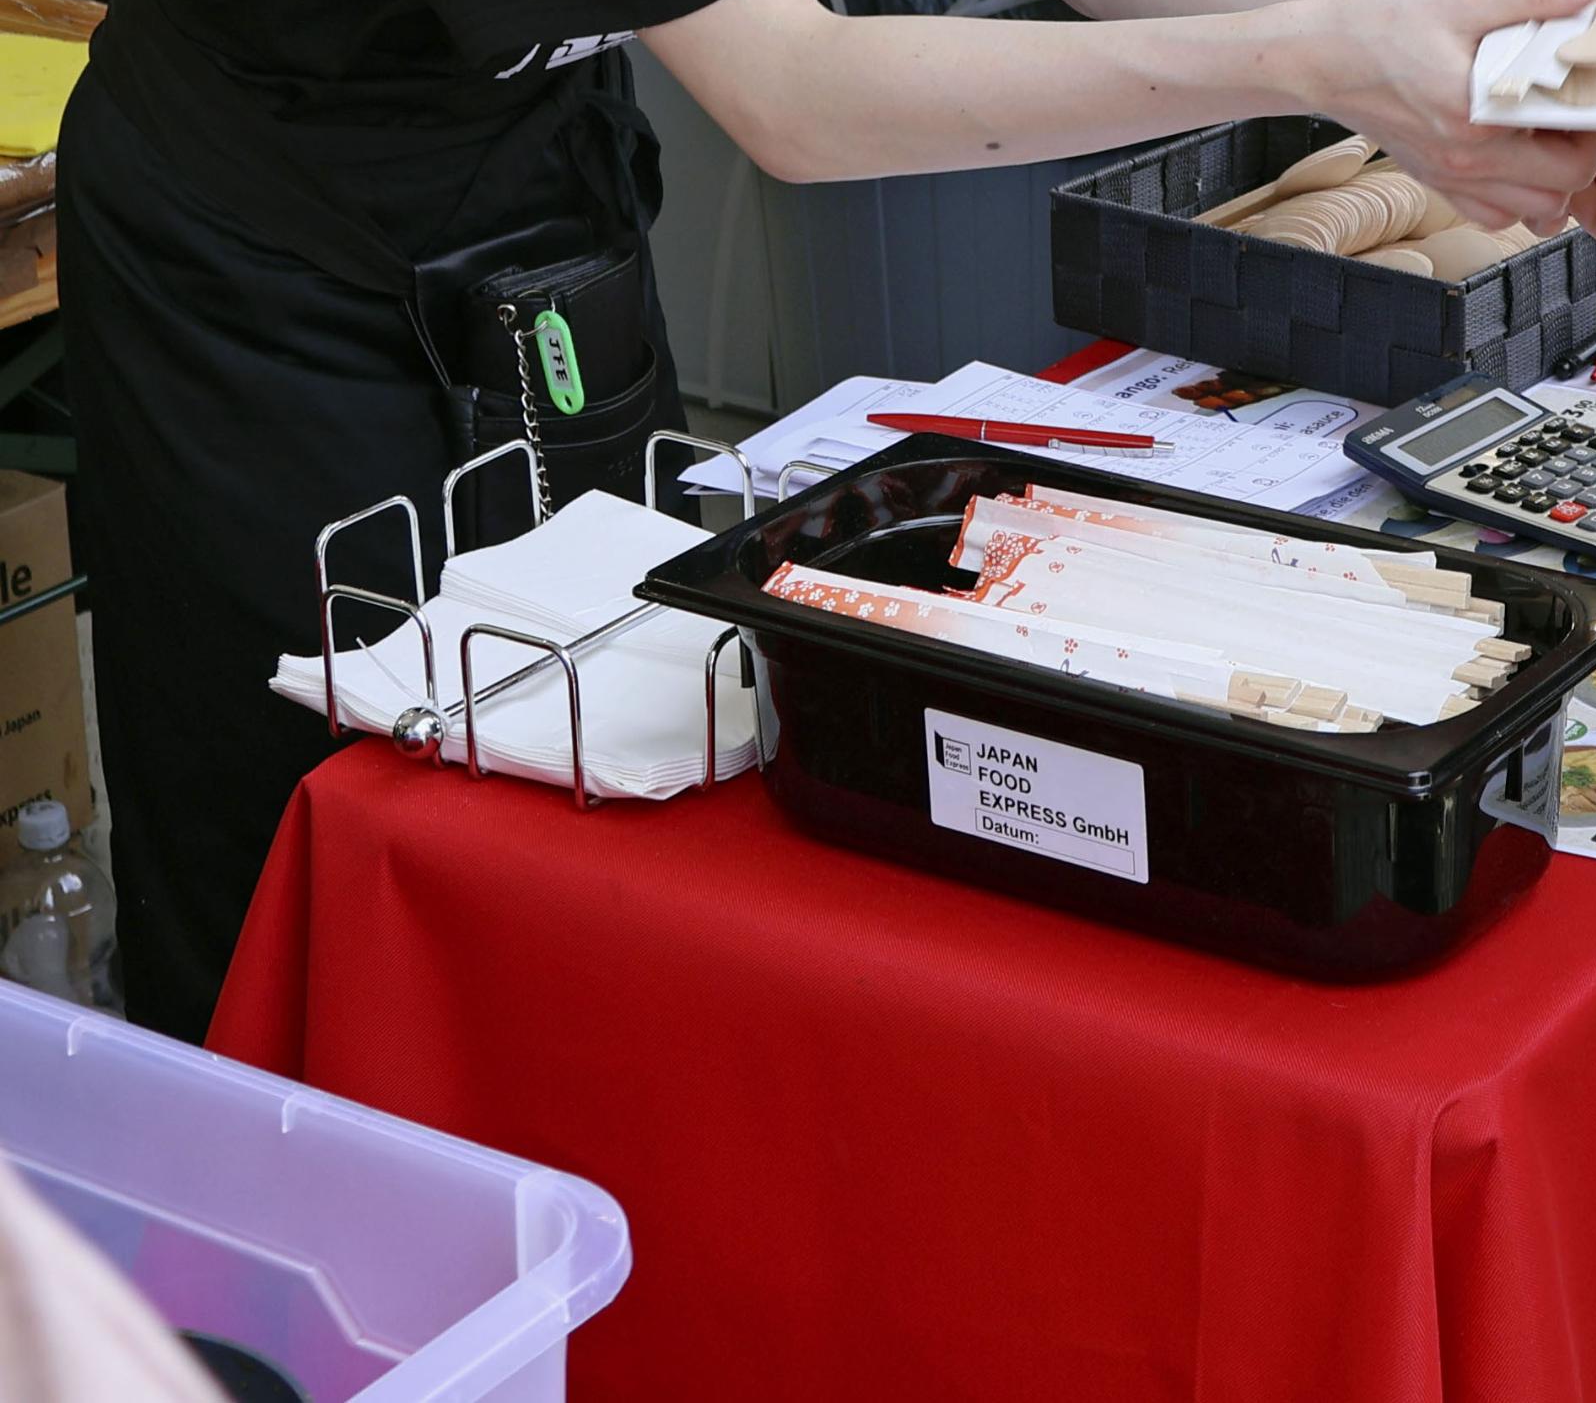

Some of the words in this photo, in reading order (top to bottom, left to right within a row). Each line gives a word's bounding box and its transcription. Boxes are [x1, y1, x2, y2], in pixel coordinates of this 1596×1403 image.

[1115, 375, 1168, 399] ango:
[1300, 411, 1344, 435] asauce
[945, 750, 960, 761] Food
[976, 744, 1038, 773] JAPAN
[978, 766, 1031, 794] FOOD
[979, 790, 1067, 828] EXPRESS
[1072, 816, 1129, 846] GmbH
[982, 816, 1040, 845] Datum:
